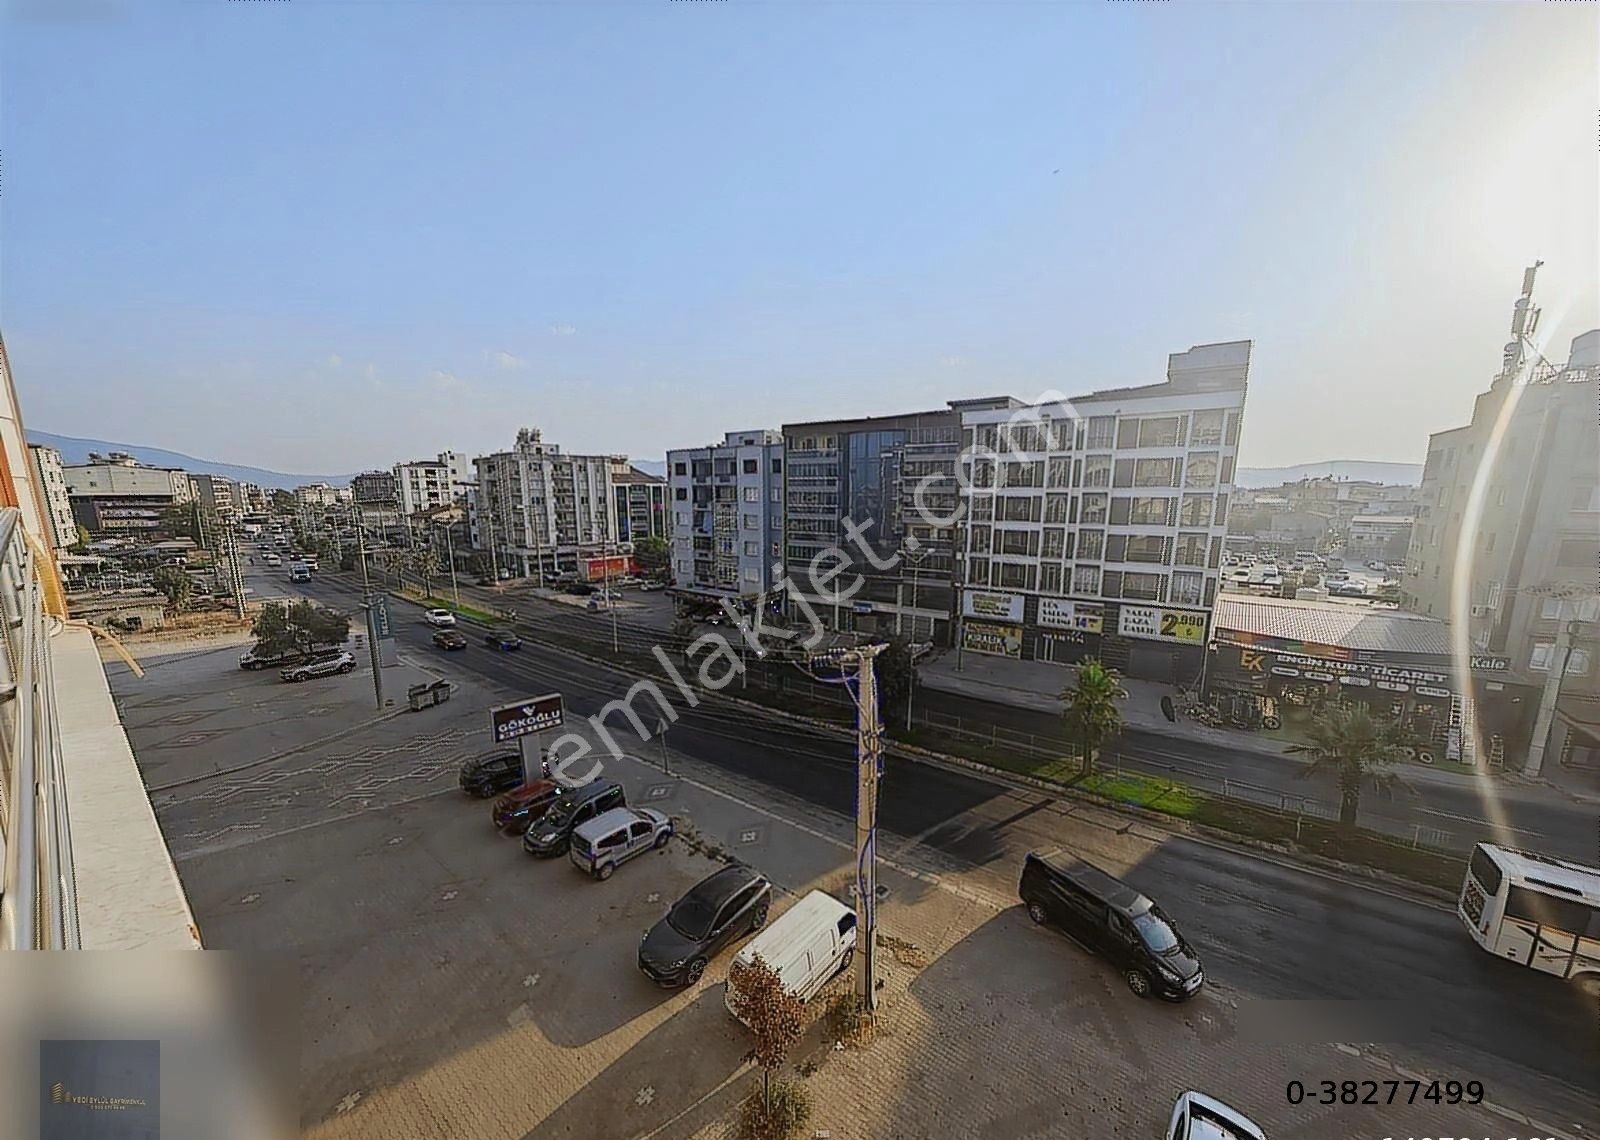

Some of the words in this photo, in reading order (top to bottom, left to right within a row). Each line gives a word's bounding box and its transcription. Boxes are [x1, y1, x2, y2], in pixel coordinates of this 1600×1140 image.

[1240, 650, 1265, 672] EK
[1371, 664, 1448, 683] TİCARET
[498, 709, 560, 733] GÖKOĞLU
